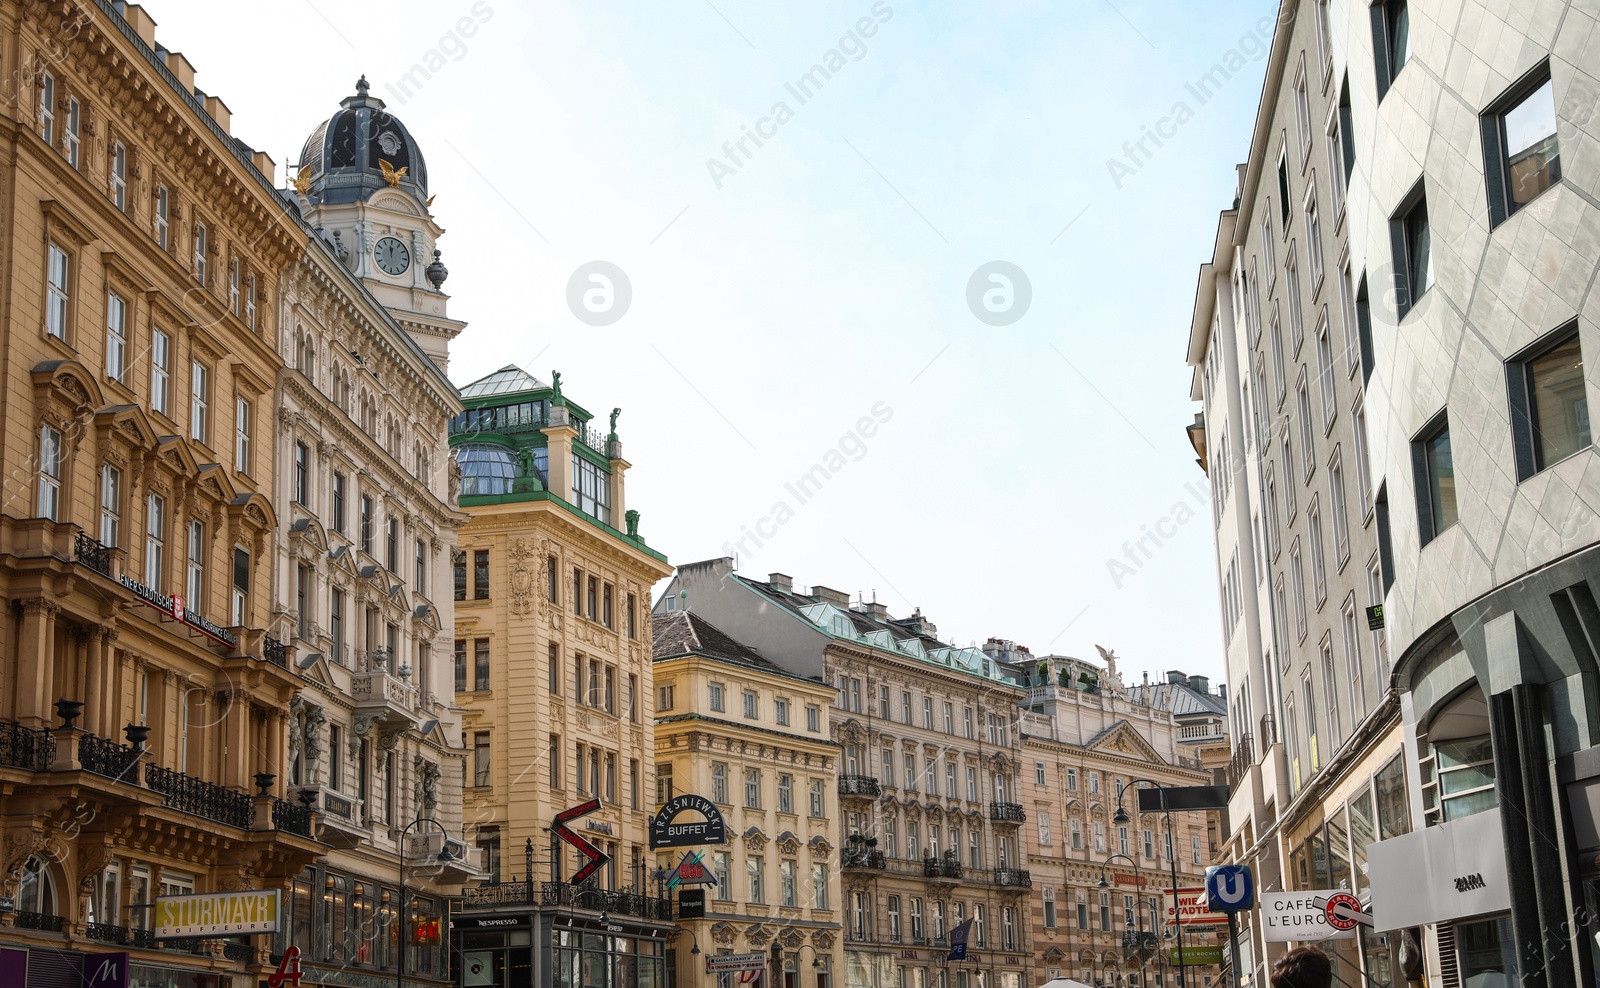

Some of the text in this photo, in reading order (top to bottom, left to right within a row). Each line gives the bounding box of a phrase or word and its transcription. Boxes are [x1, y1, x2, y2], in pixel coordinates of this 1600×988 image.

[656, 797, 721, 835] TRZESNIEWSKI
[668, 825, 707, 836] BUFFET
[583, 863, 595, 874] BAR
[1216, 874, 1245, 904] U
[1454, 873, 1486, 892] ZARA
[1274, 897, 1313, 911] CAFÉ
[1331, 895, 1358, 909] TABAK
[163, 895, 269, 928] STURMAYR
[1328, 909, 1354, 927] TRAFIK
[162, 922, 268, 935] COIFFEURE
[477, 918, 518, 927] NESPRESSO
[901, 949, 918, 959] LISKA
[1005, 956, 1020, 966] LISKA
